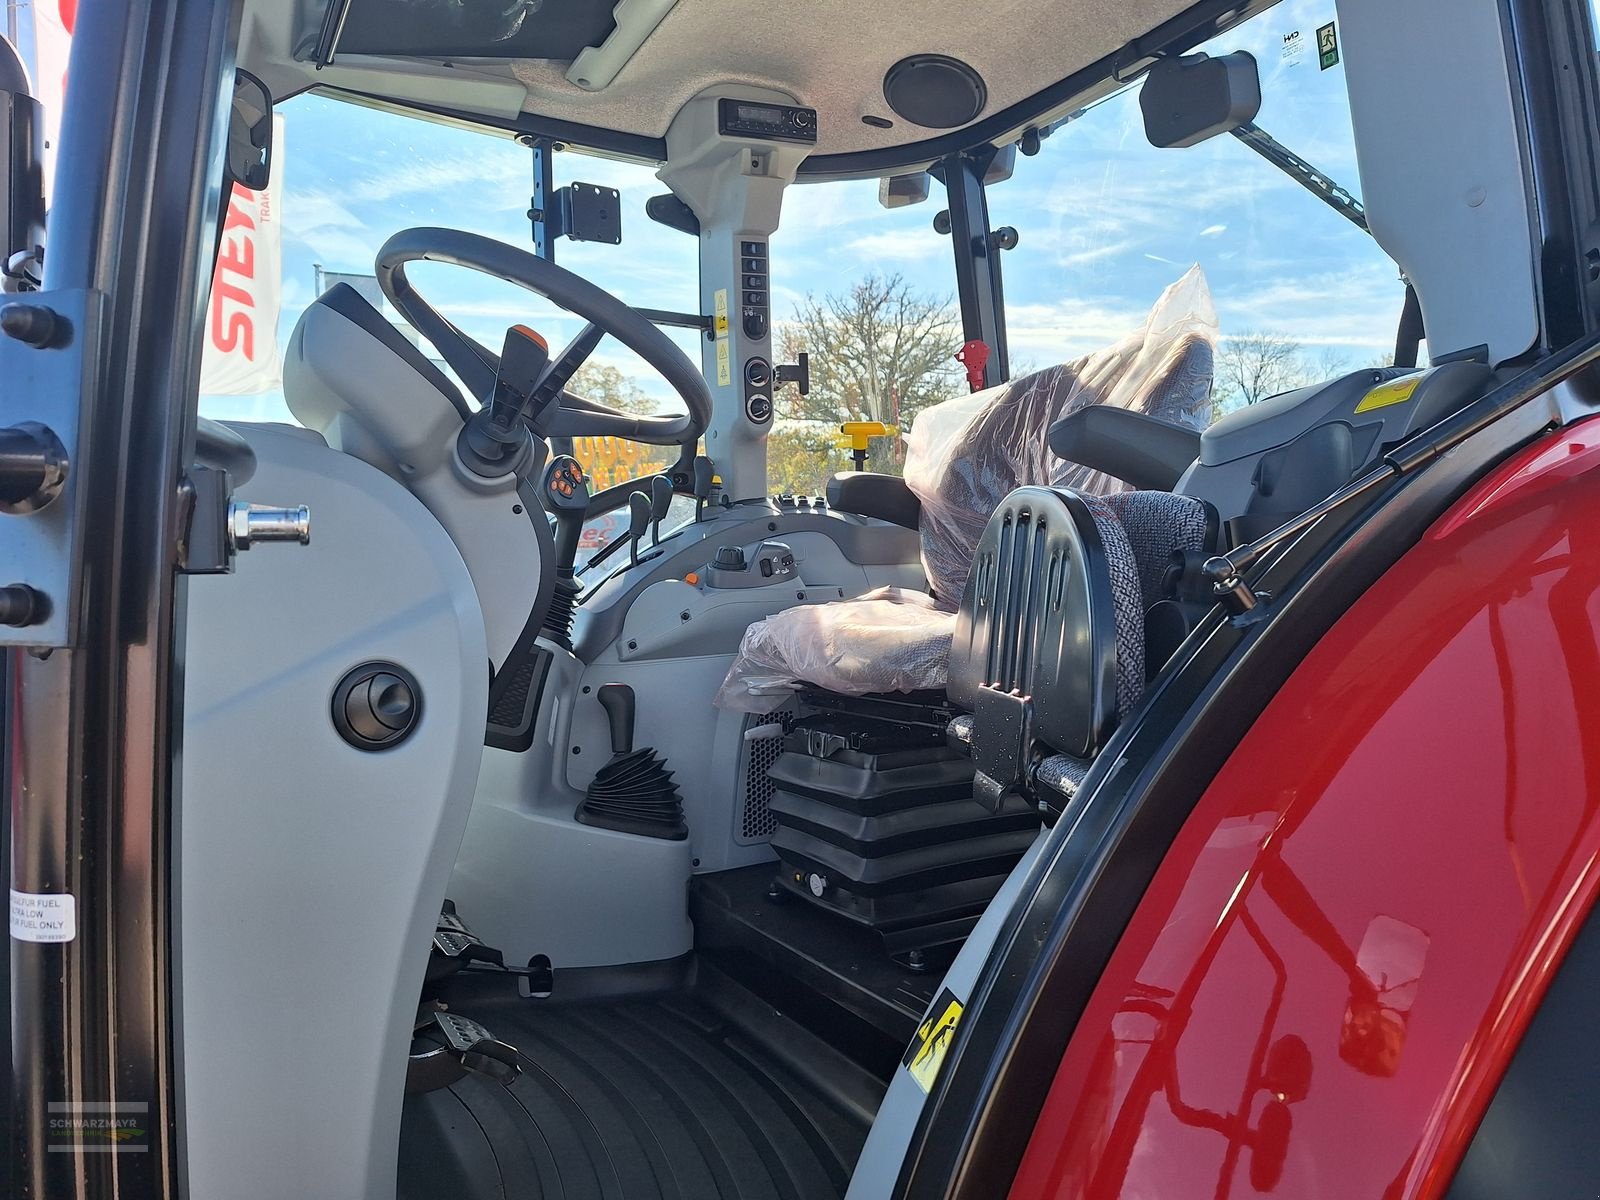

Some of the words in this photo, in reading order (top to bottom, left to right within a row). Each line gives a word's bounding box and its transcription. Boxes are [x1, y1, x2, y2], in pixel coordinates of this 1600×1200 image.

[37, 899, 60, 908] FUEL
[26, 910, 43, 919] LOW
[39, 920, 64, 929] ONLY
